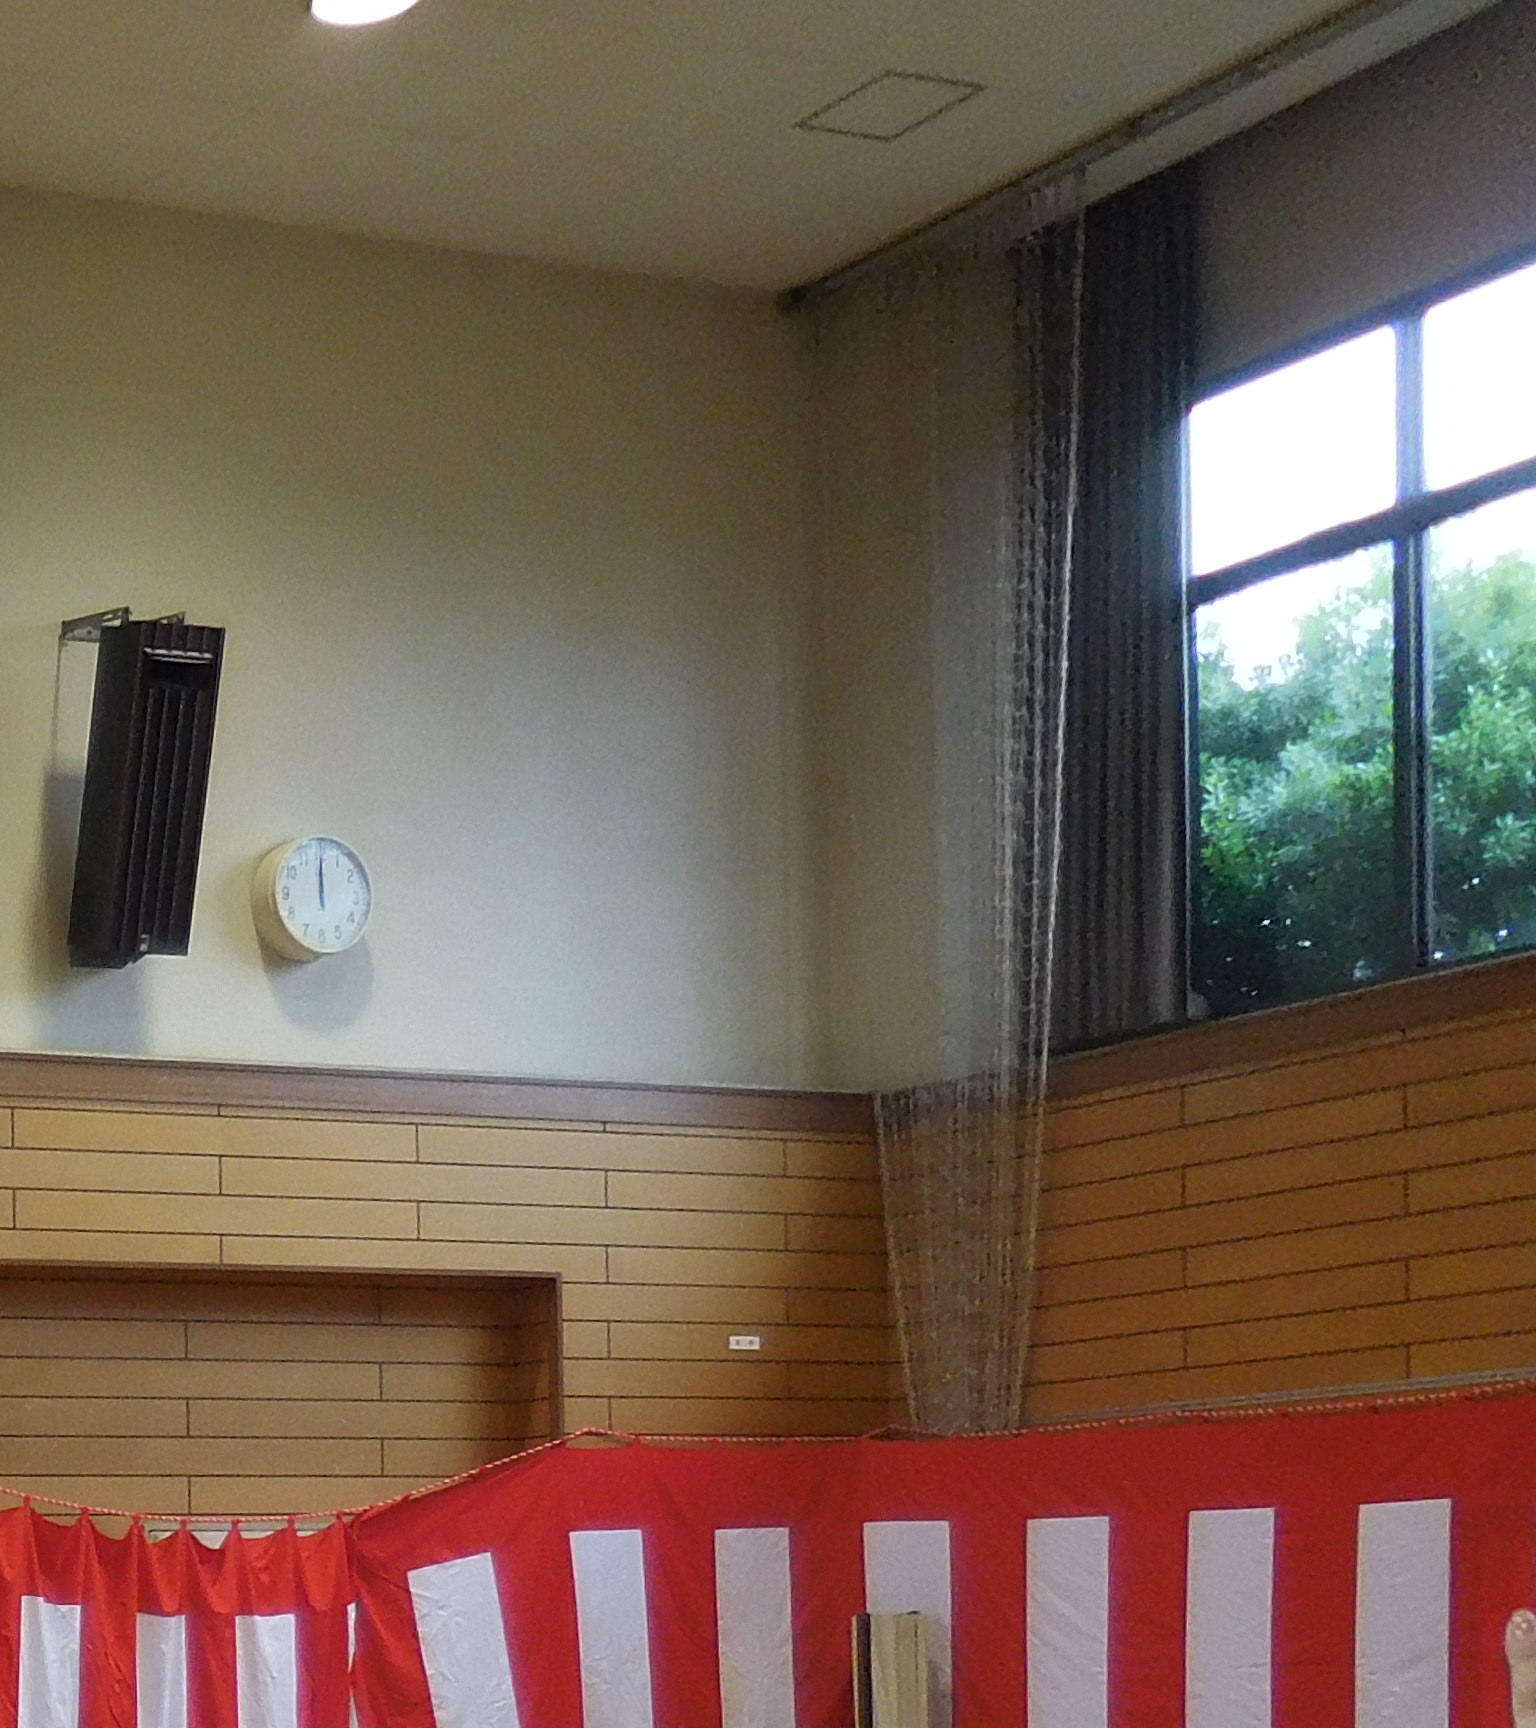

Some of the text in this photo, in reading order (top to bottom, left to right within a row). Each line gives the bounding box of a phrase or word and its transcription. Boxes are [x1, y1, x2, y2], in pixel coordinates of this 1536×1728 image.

[346, 868, 354, 884] 2
[281, 886, 290, 901] 9
[352, 890, 360, 906] 3
[346, 910, 355, 924] 4
[301, 923, 310, 937] 7
[318, 928, 326, 944] 6
[334, 925, 342, 940] 5
